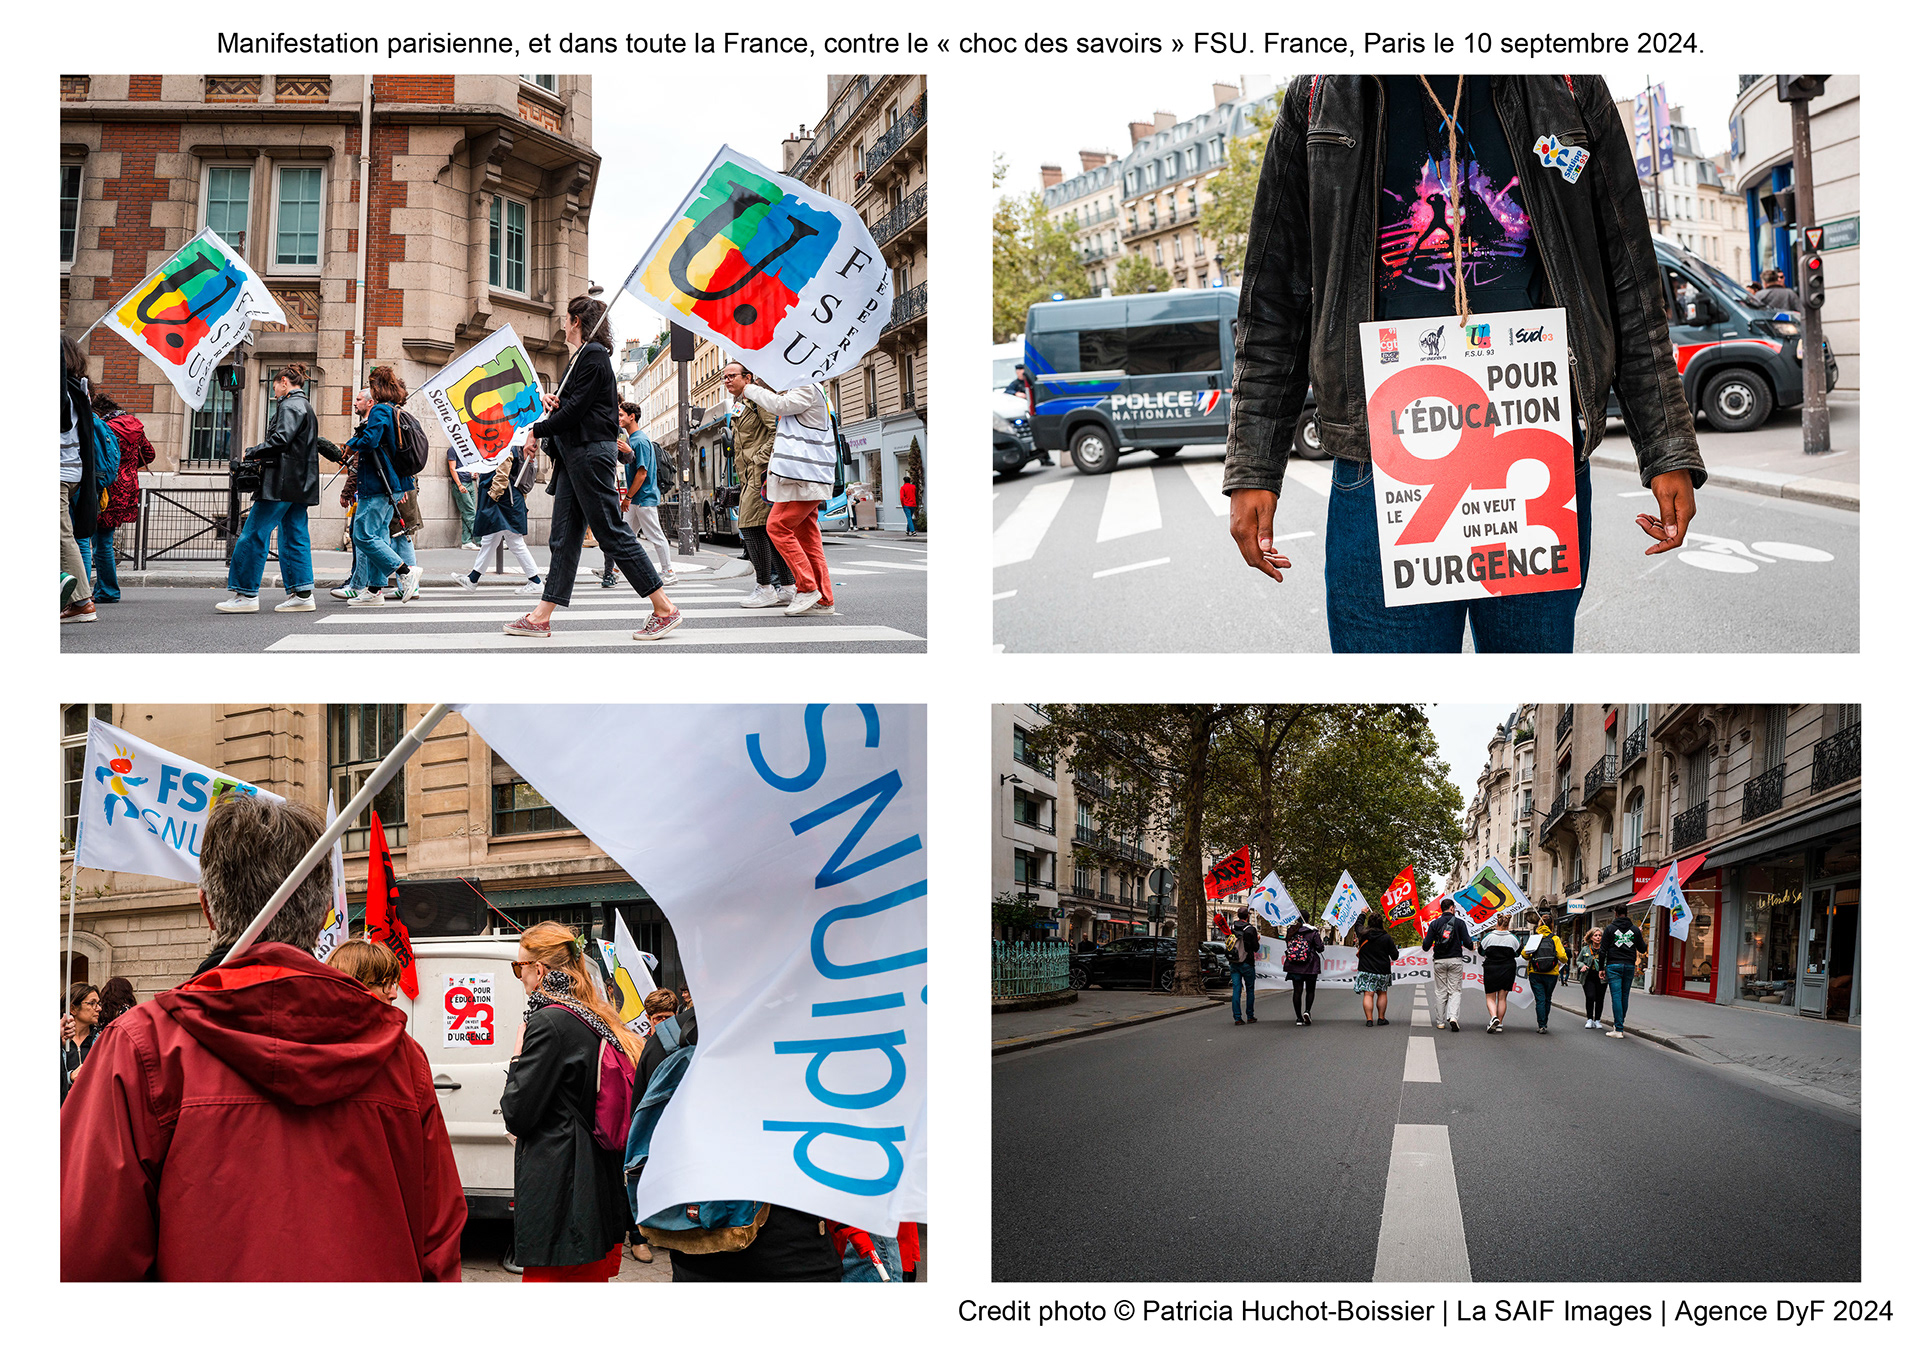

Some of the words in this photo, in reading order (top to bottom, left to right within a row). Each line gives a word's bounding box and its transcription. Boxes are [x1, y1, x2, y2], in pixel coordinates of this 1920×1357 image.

[1579, 154, 1589, 164] 93
[1380, 339, 1398, 350] cgt
[1541, 333, 1554, 342] 93
[1487, 361, 1557, 392] POUR
[1110, 390, 1194, 411] POLICE
[1111, 408, 1192, 421] NATIONALE
[1390, 397, 1561, 435] L'ÉDUCATION
[428, 389, 452, 423] Seine
[447, 423, 474, 459] Saint
[1367, 364, 1582, 597] 93
[1385, 489, 1422, 504] DANS
[1461, 502, 1480, 515] ON
[1484, 498, 1516, 514] VEUT
[1387, 511, 1403, 524] LE
[1463, 524, 1481, 538] UN
[1485, 521, 1518, 537] PLAN
[1393, 544, 1569, 589] D'URGENCE
[1767, 888, 1791, 906] Monde
[450, 994, 491, 1003] L'ÉDUCATION
[445, 986, 495, 1046] 93
[447, 1032, 491, 1041] D'URGENCE
